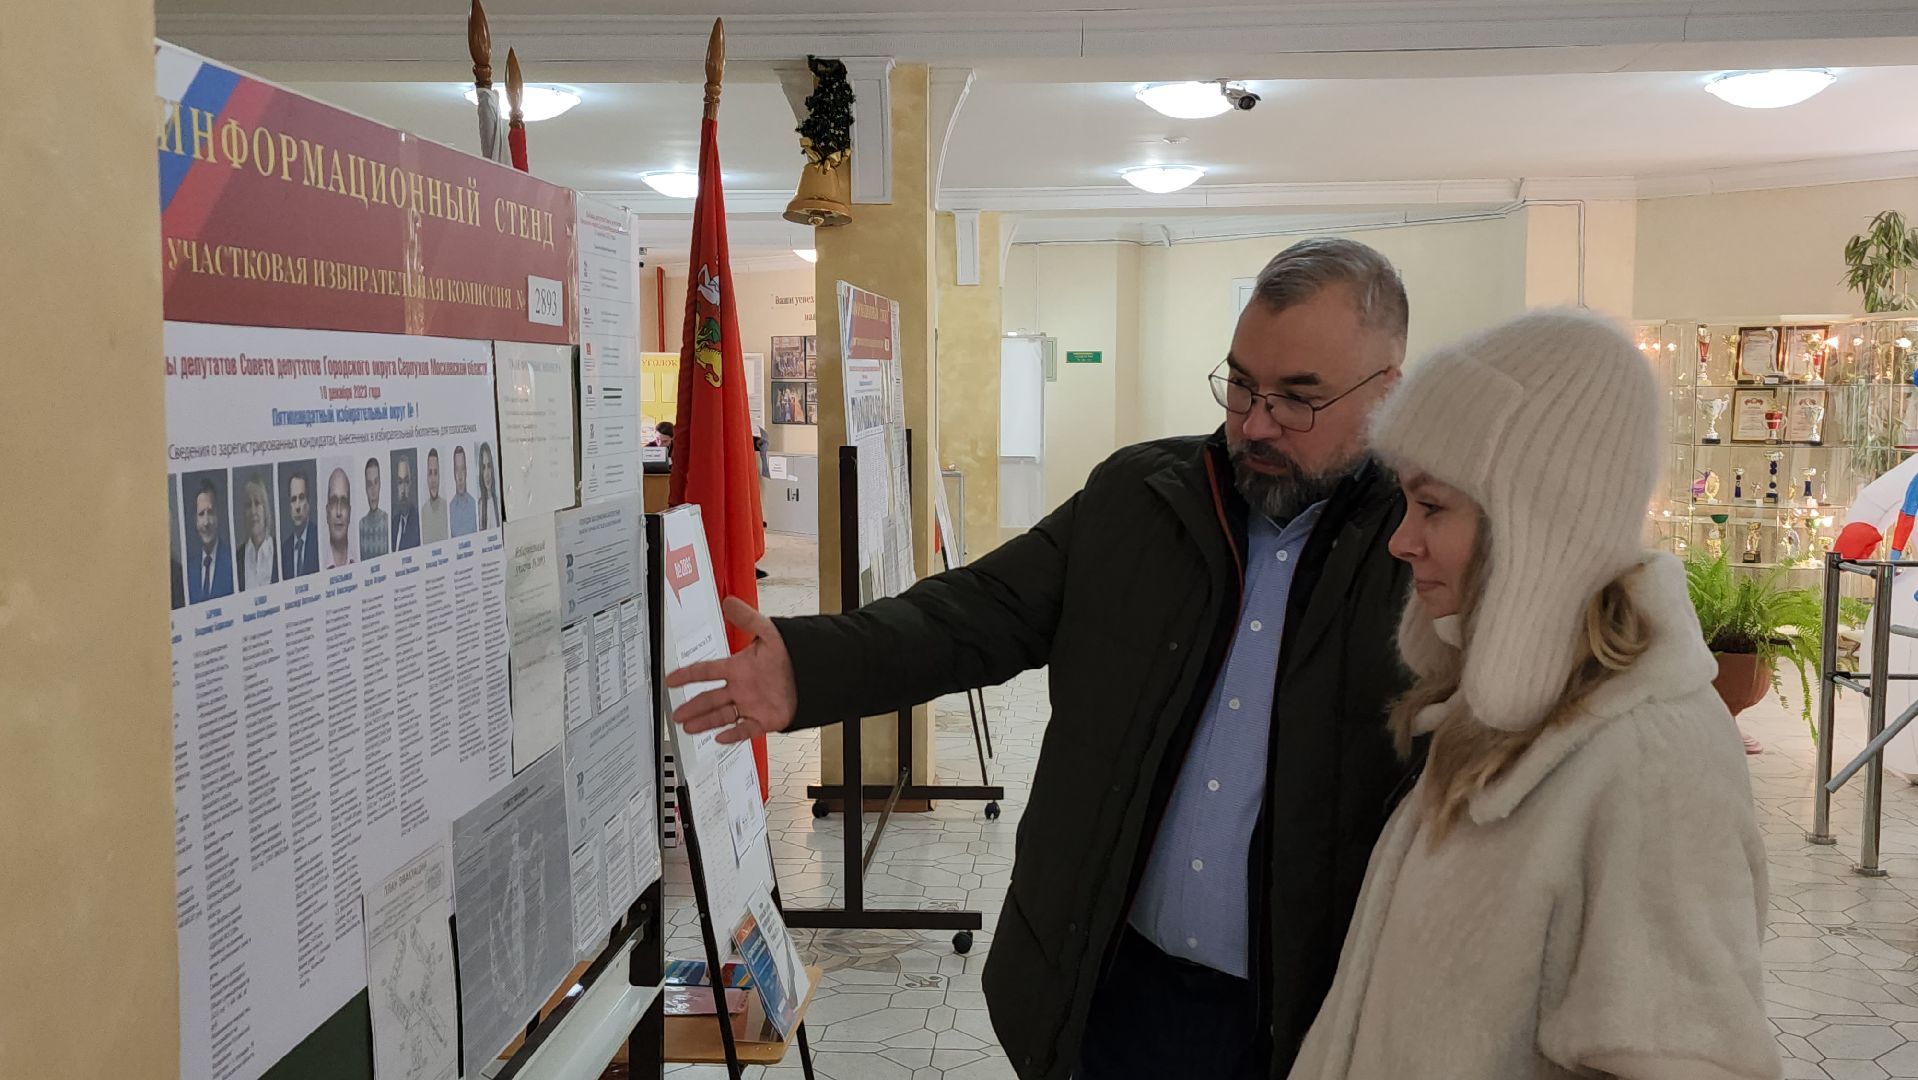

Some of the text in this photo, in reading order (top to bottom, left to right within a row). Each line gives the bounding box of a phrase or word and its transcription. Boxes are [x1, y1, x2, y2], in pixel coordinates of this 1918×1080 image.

[158, 101, 481, 227] ИНФОРМАЦИОННЫЙ
[494, 199, 555, 248] СТЕНД
[168, 237, 308, 286] УЧАСТКОВАЯ
[314, 259, 444, 302] ИЗБИРАТЕЛЬНАЯ
[448, 279, 512, 310] КОМИССИЯ
[535, 288, 558, 316] 2893
[181, 355, 238, 379] депутатов
[240, 353, 275, 376] Совета
[277, 357, 321, 379] депутатов
[323, 355, 370, 379] Городского
[372, 359, 397, 379] округа
[168, 444, 210, 461] Сведения
[212, 447, 217, 456] о
